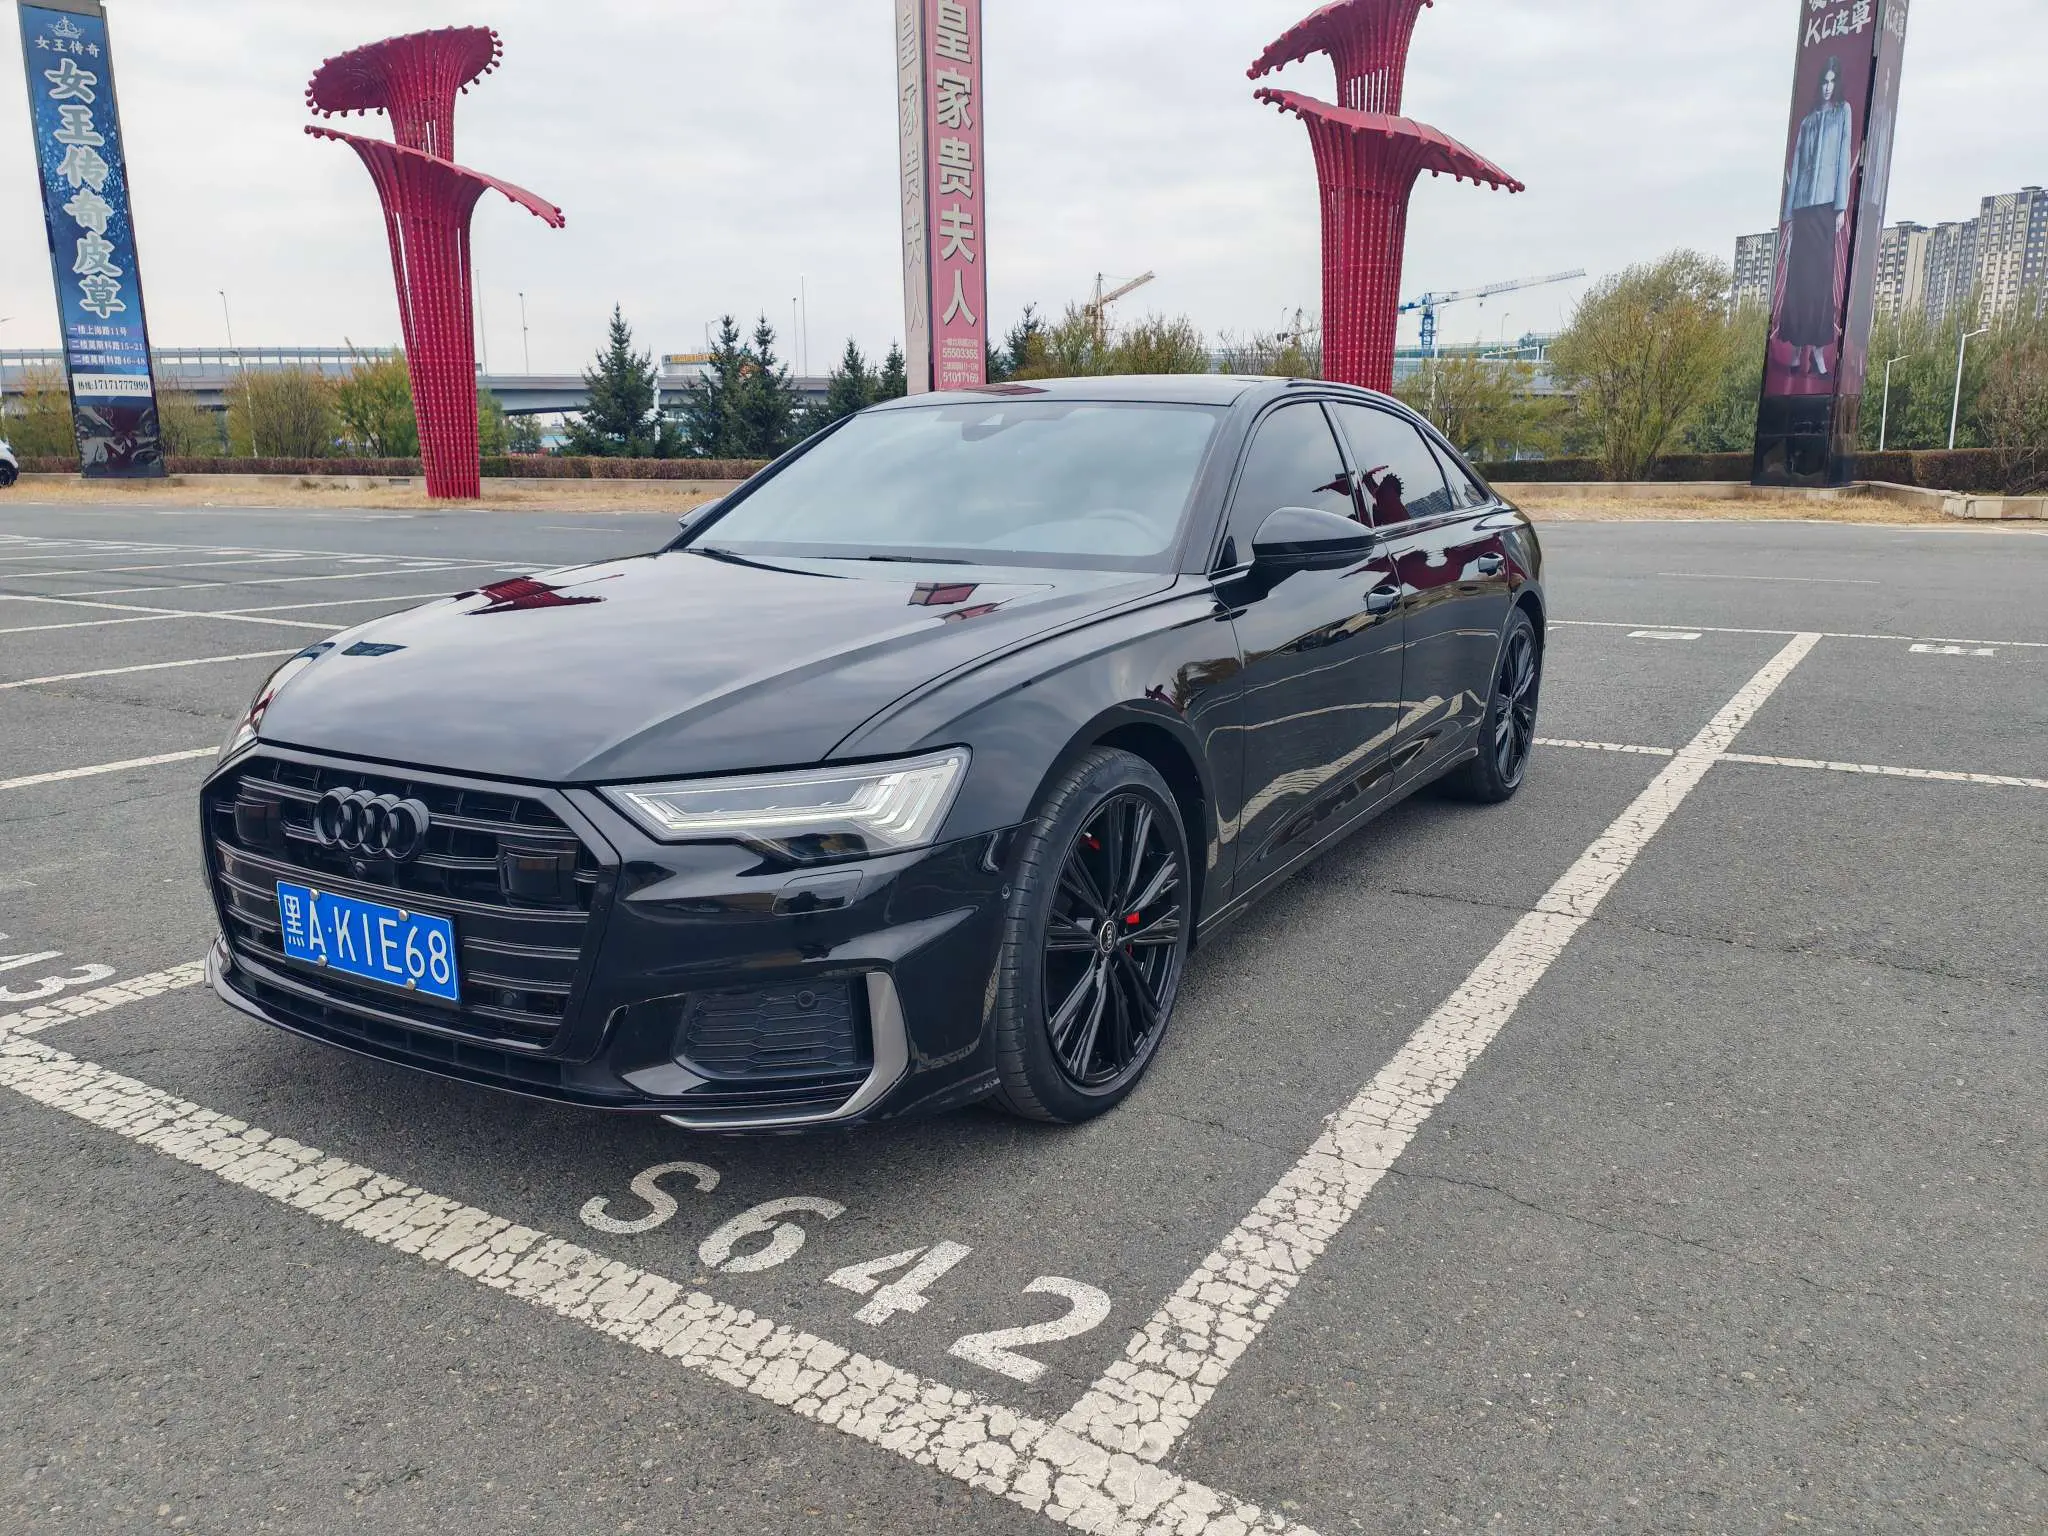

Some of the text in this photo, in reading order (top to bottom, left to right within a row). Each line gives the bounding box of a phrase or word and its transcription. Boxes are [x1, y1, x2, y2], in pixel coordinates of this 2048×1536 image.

[35, 35, 100, 58] 女王传奇
[935, 0, 978, 327] 皇家贵夫人
[44, 57, 127, 319] 女王传奇皮草
